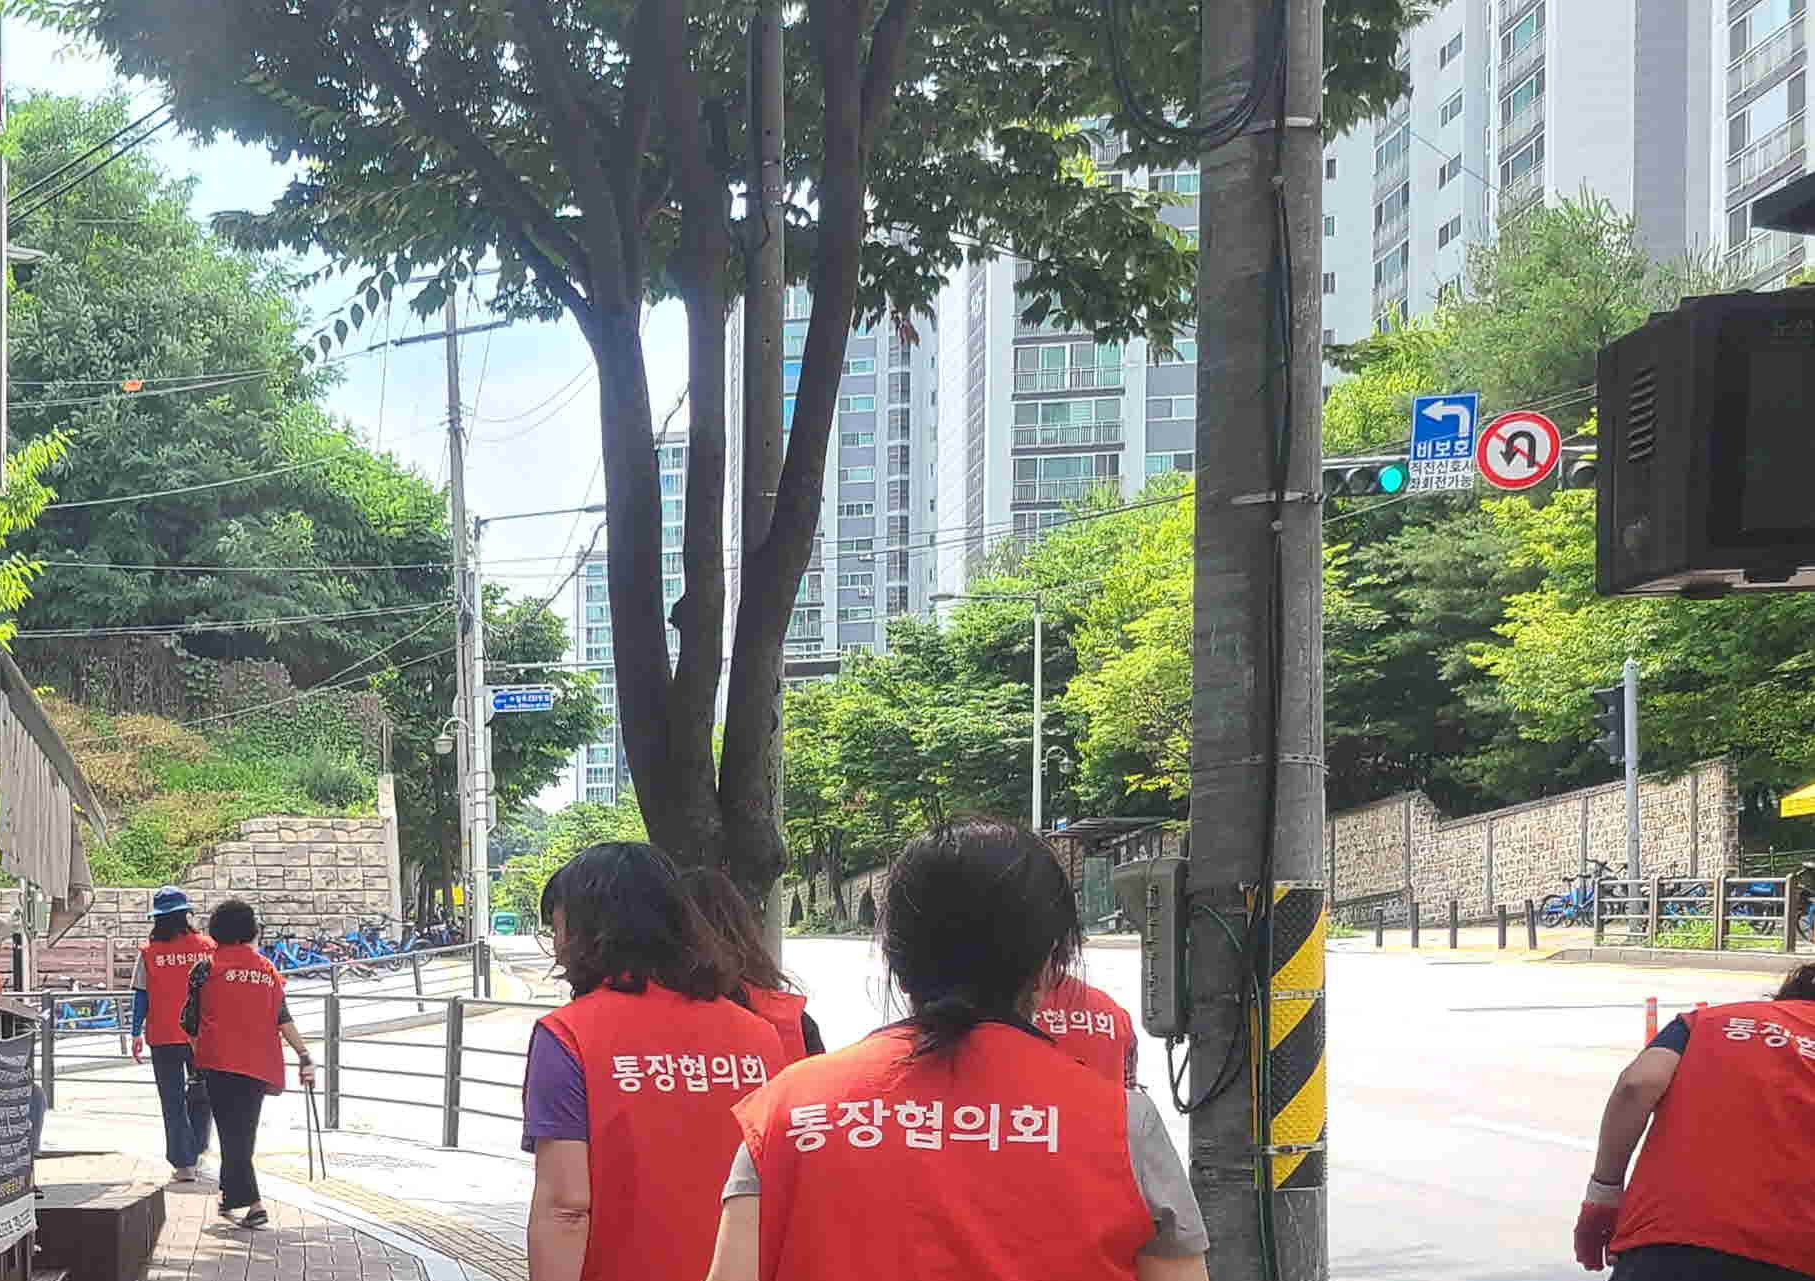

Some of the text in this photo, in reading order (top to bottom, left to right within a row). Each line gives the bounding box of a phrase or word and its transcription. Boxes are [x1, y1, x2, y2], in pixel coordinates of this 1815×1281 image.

[1417, 438, 1470, 459] 비보호
[1409, 460, 1473, 475] 직진신호시
[225, 969, 276, 988] 통장협의
[1033, 1008, 1117, 1040] 협의회
[612, 1054, 768, 1093] 통장협의회
[785, 1098, 1059, 1154] 통장협의회
